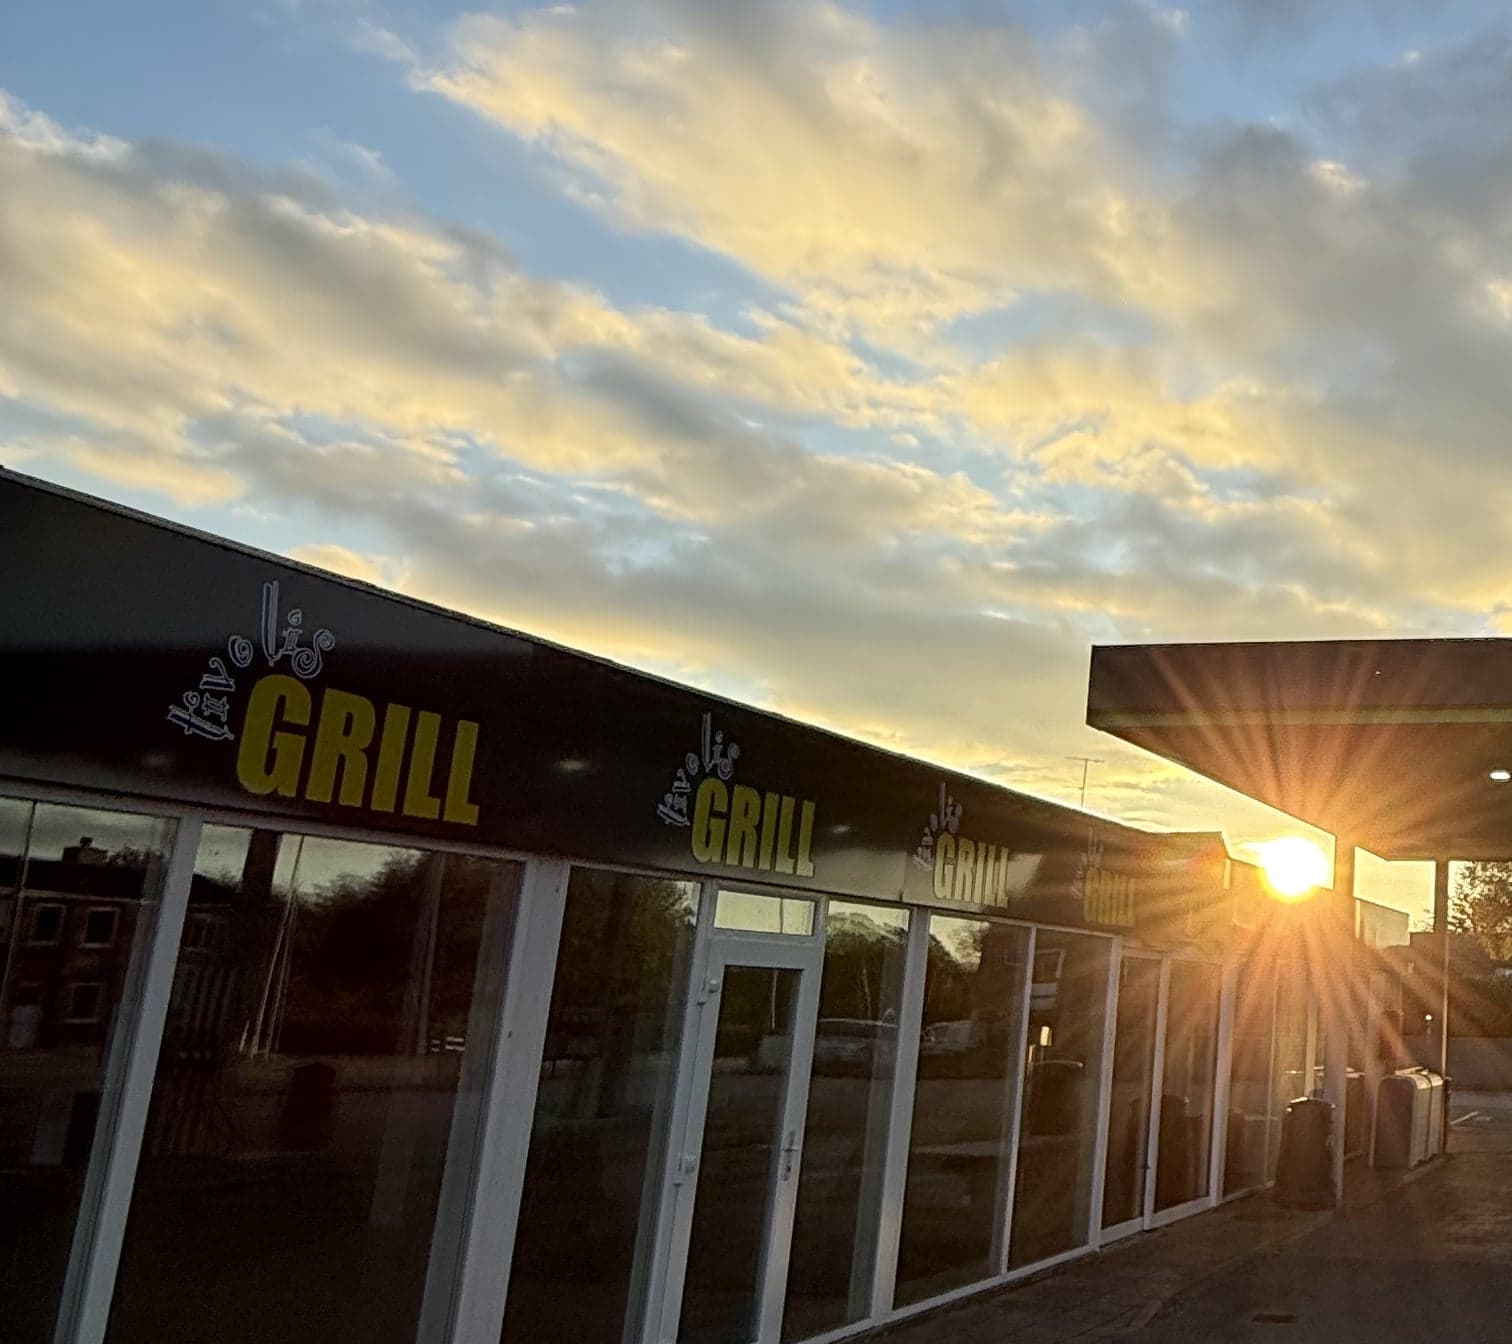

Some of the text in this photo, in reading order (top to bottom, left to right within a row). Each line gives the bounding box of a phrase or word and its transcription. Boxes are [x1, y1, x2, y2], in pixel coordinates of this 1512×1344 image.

[236, 674, 480, 826] GRILL
[691, 777, 816, 877] GRILL
[934, 833, 1009, 909] GRILL
